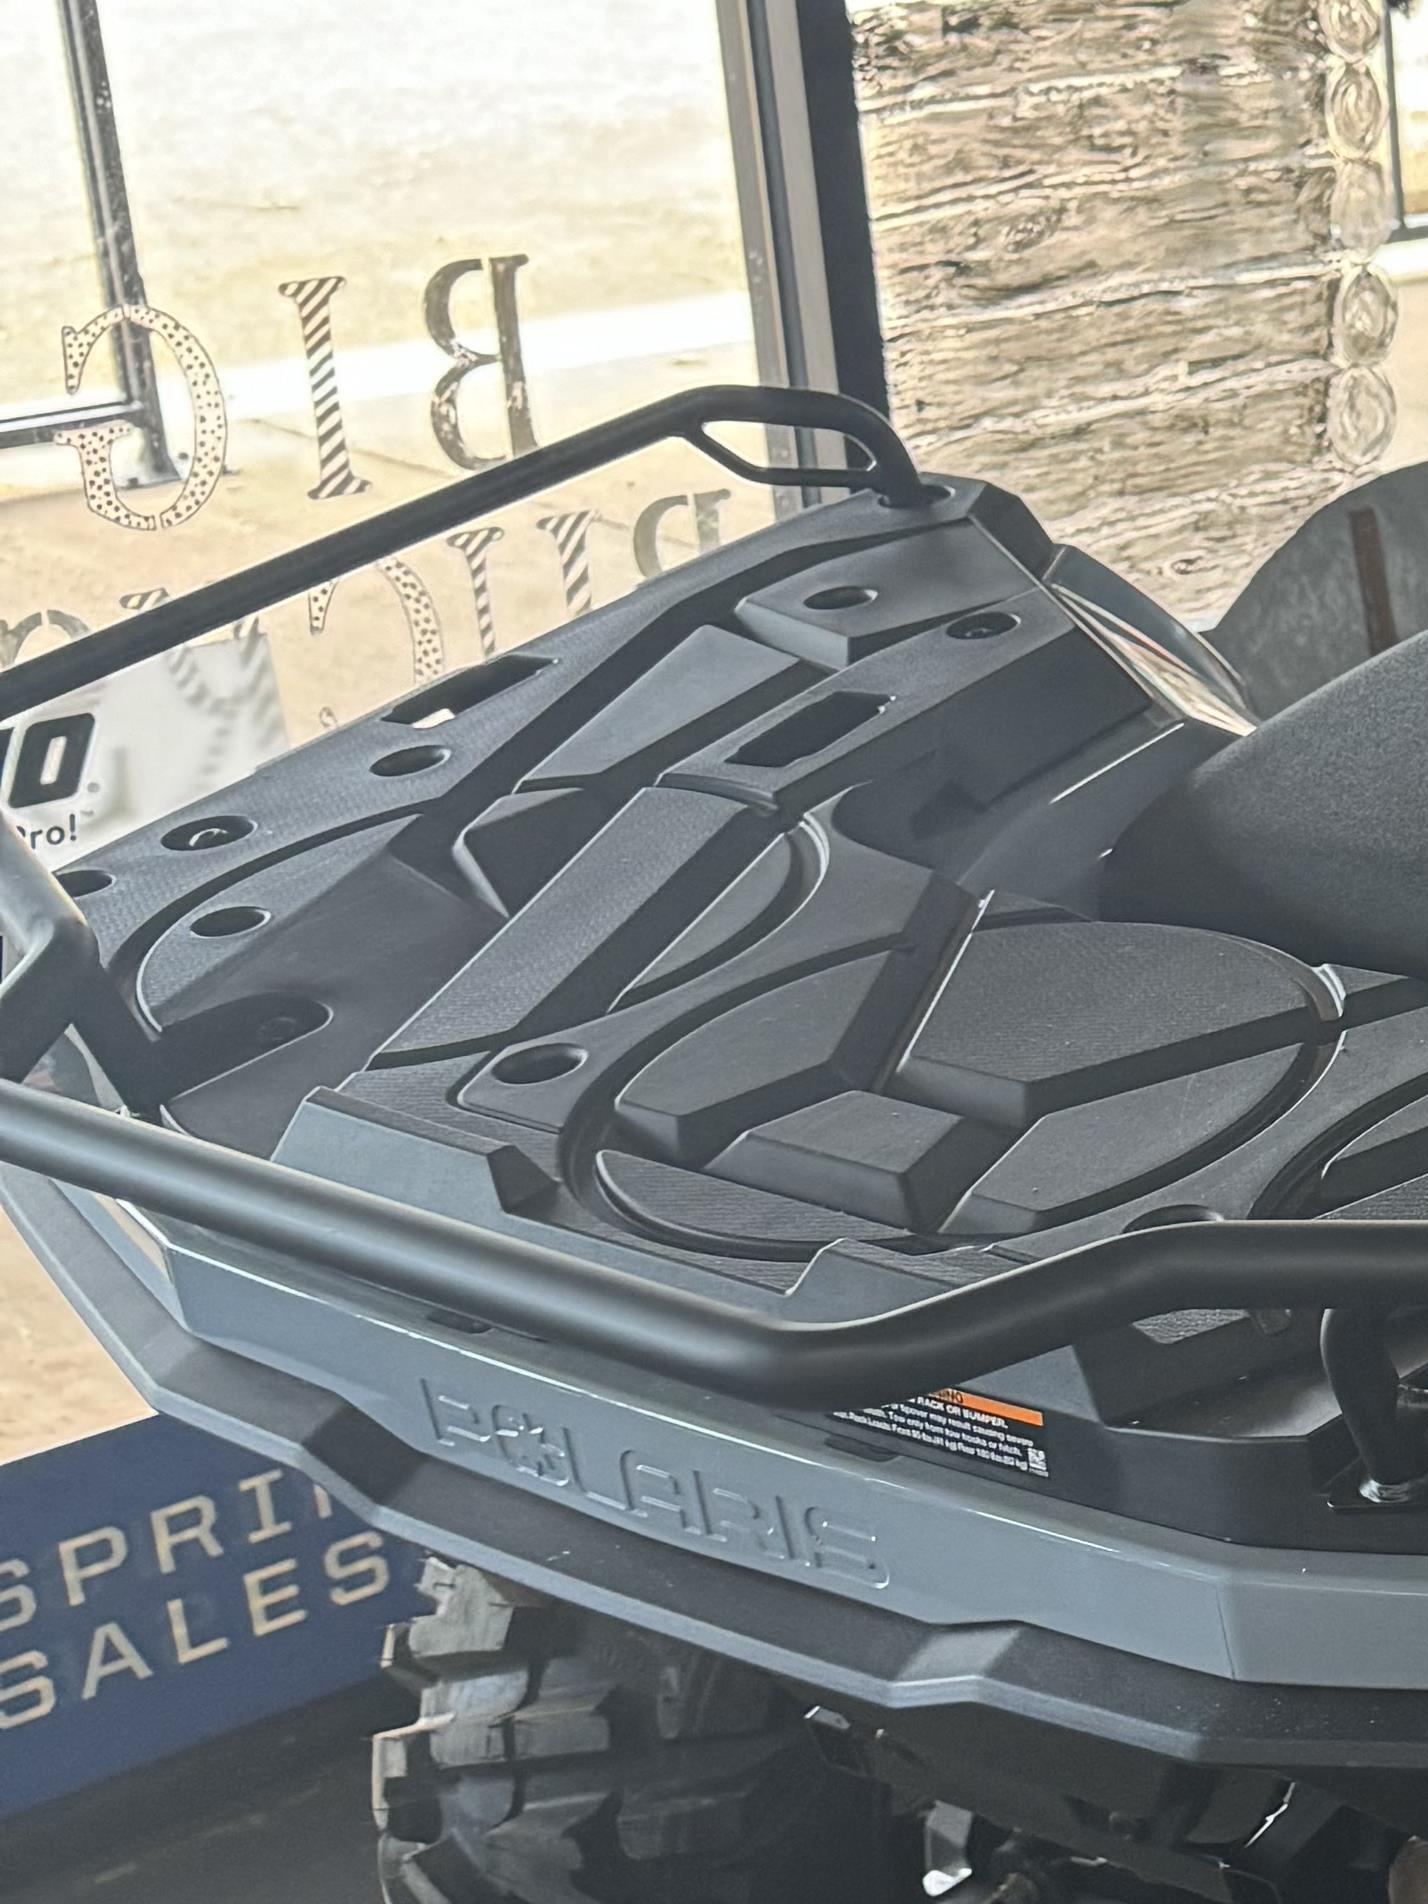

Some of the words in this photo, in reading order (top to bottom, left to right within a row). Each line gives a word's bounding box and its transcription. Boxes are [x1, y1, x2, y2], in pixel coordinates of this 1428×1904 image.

[0, 1469, 332, 1632] SPRI
[419, 1379, 890, 1590] POLARIS
[0, 1531, 391, 1730] SALES
